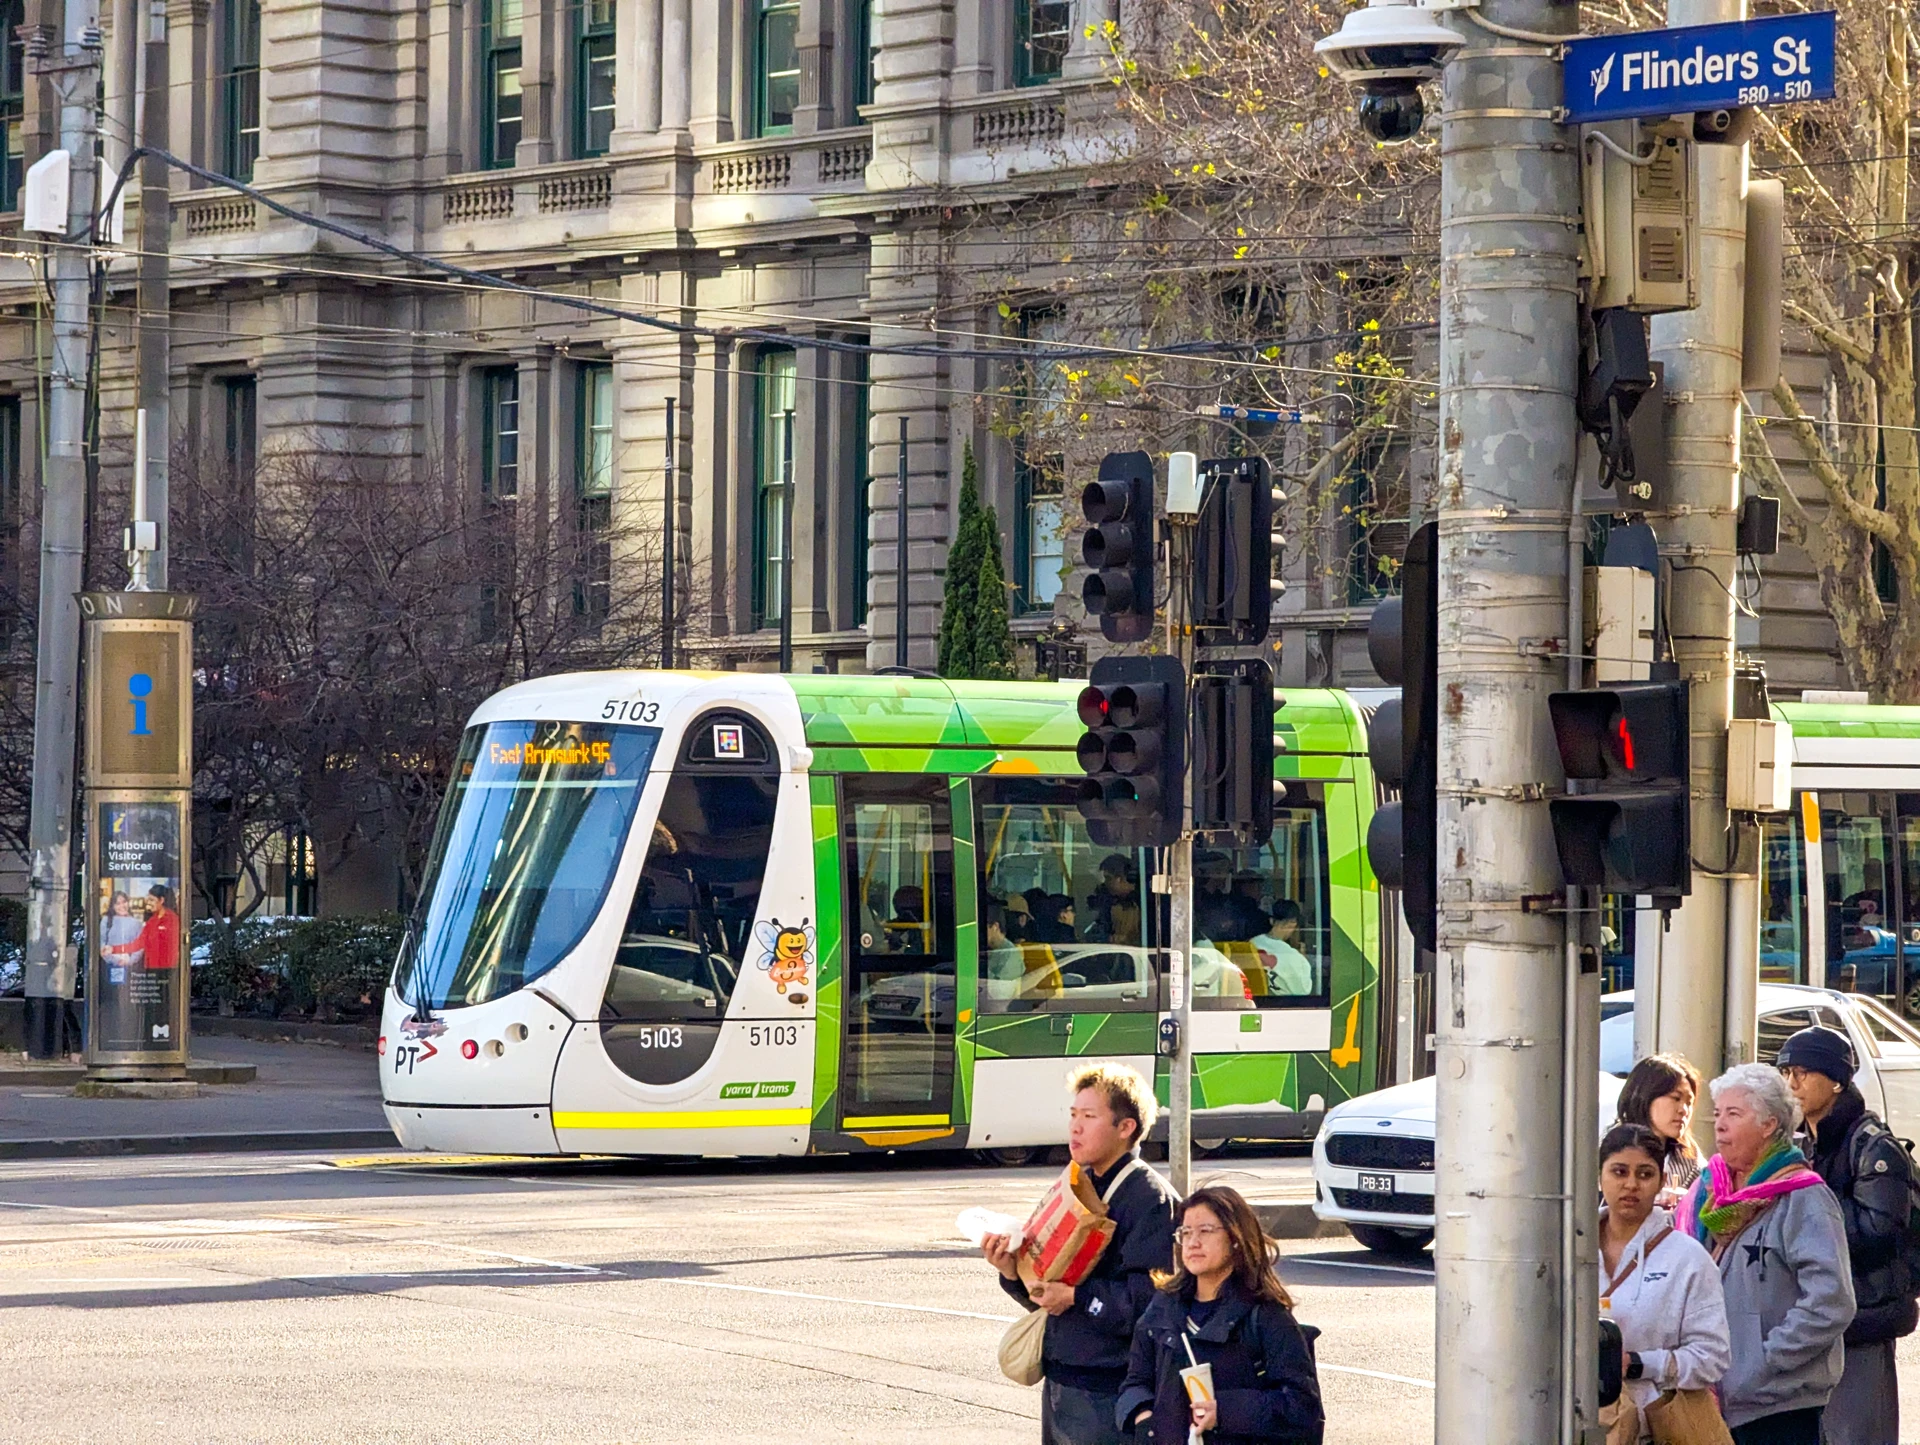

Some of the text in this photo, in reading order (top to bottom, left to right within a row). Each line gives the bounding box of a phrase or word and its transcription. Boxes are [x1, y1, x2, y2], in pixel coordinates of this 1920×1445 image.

[1622, 36, 1811, 92] Flinders St
[1738, 85, 1769, 105] 580
[1785, 80, 1812, 100] 510
[601, 700, 660, 722] 5103
[108, 841, 165, 850] Melbourne
[108, 851, 144, 861] Visitor
[108, 861, 153, 871] Services
[640, 1027, 683, 1048] 5103
[750, 1026, 797, 1046] 5103
[725, 1084, 790, 1096] yarra trams
